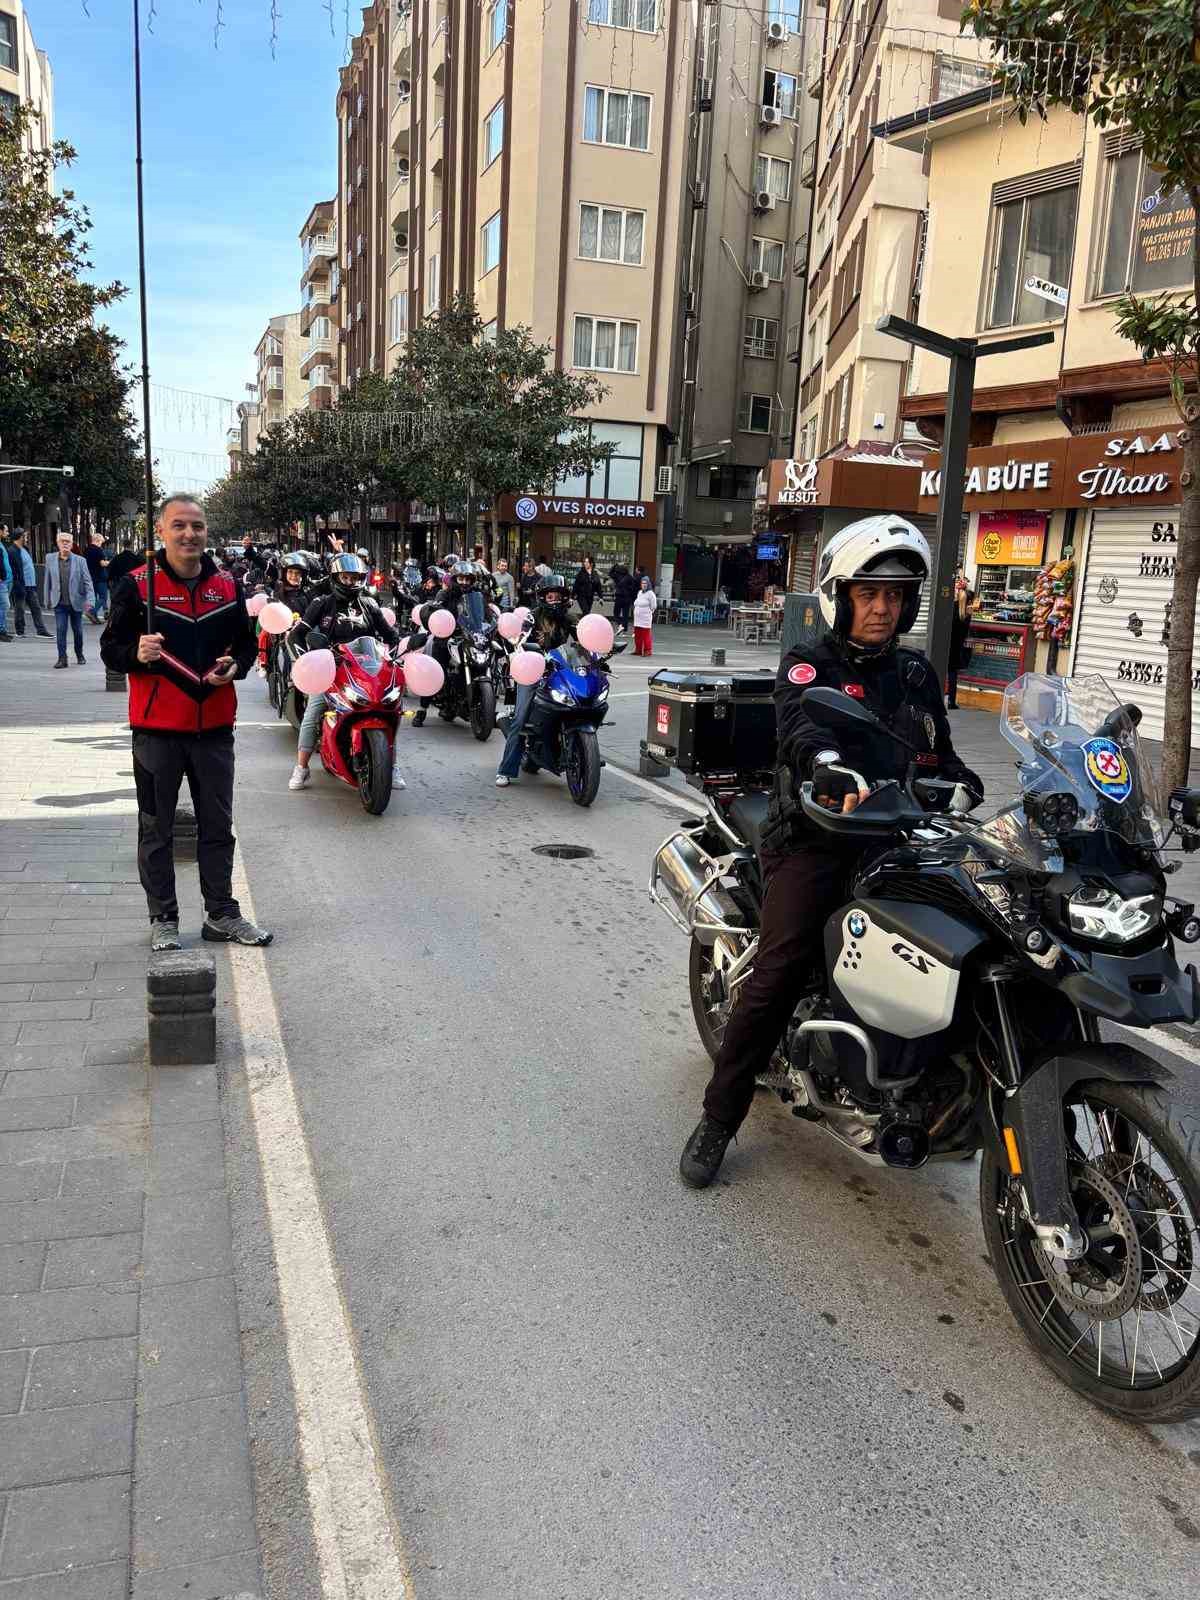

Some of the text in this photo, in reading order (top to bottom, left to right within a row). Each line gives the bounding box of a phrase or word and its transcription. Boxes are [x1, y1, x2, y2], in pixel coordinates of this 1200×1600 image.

[986, 459, 1049, 491] BÜFE
[1078, 462, 1168, 499] İlhan
[778, 491, 819, 503] MESUT
[542, 500, 645, 518] YVES ROCHER
[572, 518, 613, 527] FRANCE
[657, 707, 669, 723] 112
[891, 942, 936, 974] GS
